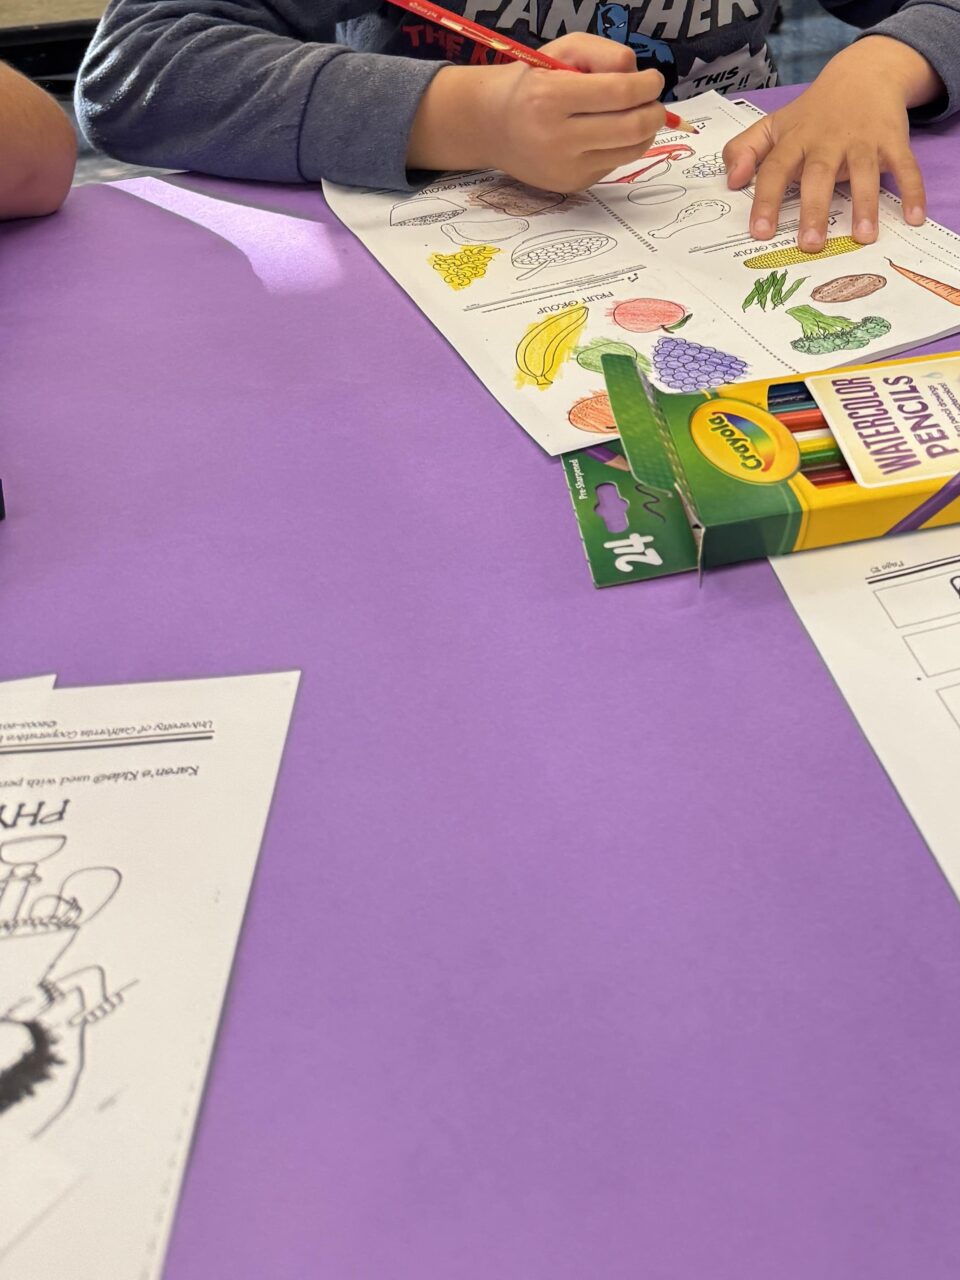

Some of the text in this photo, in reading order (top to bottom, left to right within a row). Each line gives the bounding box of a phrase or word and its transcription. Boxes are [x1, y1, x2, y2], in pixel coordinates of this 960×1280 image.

[693, 66, 739, 89] THIS
[581, 291, 615, 305] FRUIT
[831, 376, 922, 475] WATERCOLOR
[884, 375, 960, 458] PENCILS
[708, 414, 762, 471] Crayola
[603, 533, 664, 572] 24
[27, 777, 57, 789] with
[60, 774, 91, 786] used
